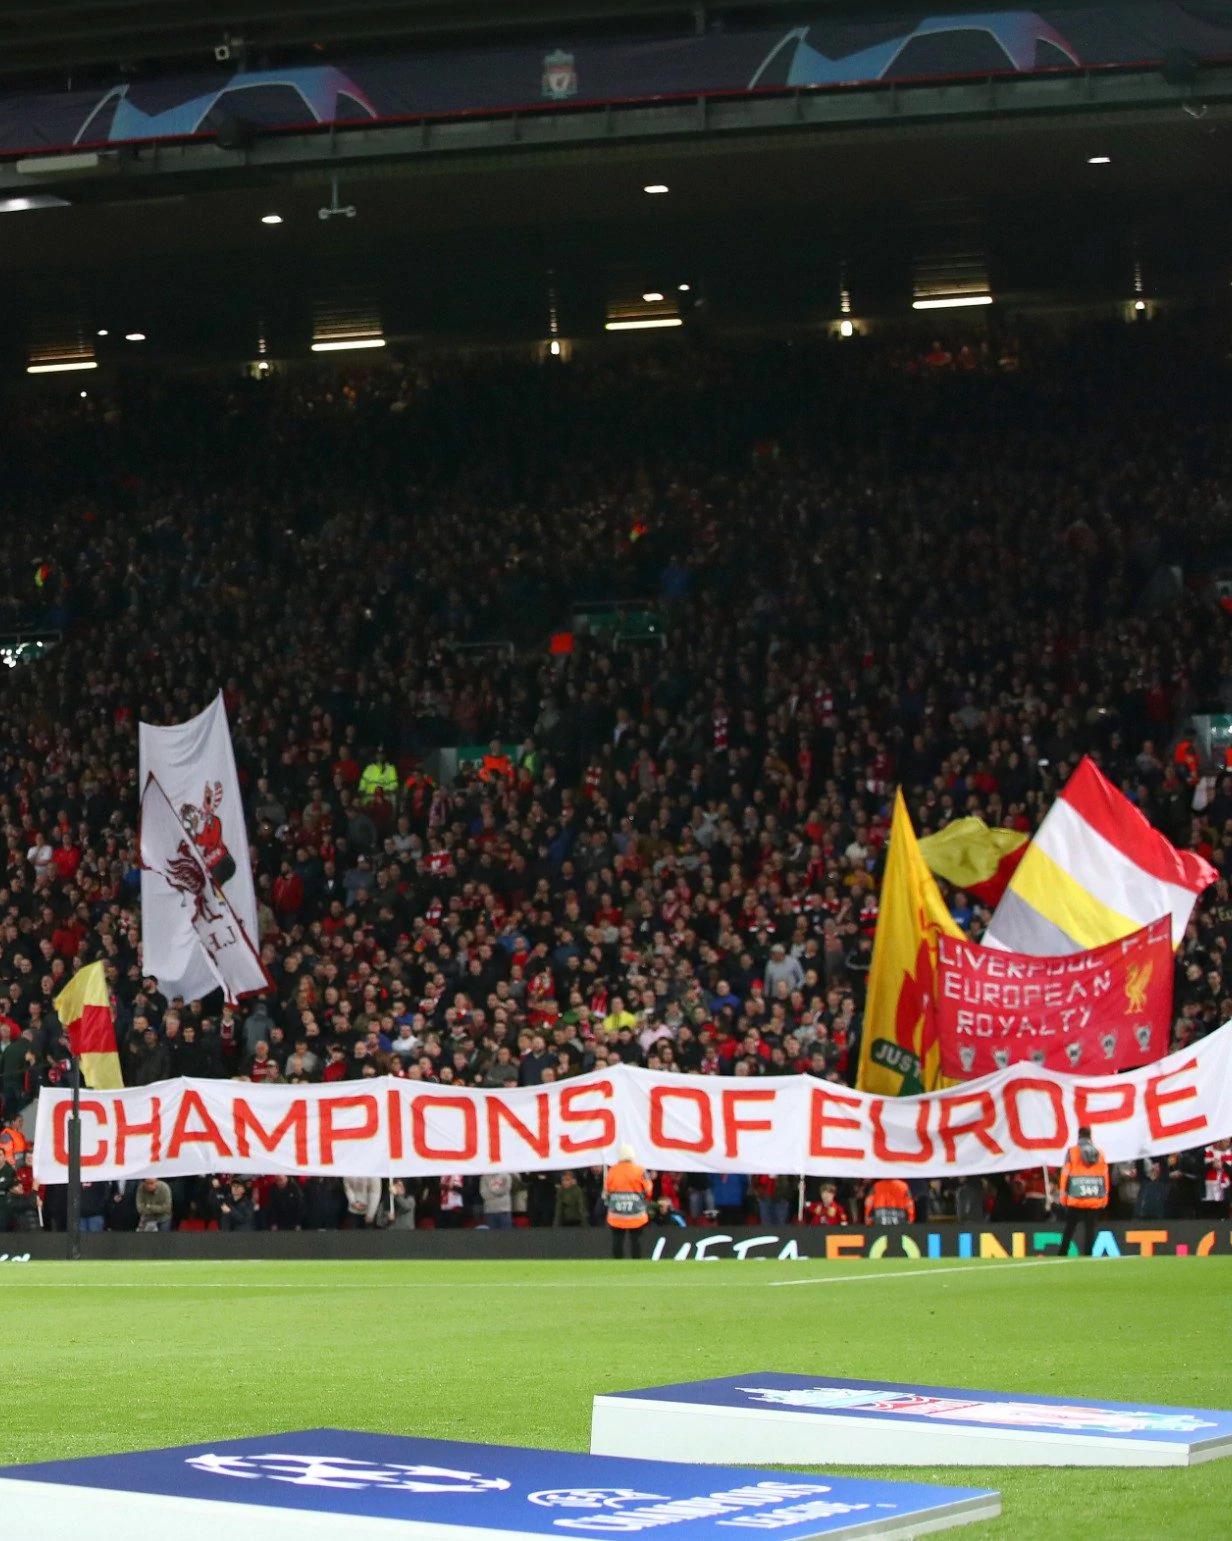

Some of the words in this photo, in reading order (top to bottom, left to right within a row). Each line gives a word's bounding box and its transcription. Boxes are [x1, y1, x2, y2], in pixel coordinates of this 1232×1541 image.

[943, 969, 1113, 1009] EUROPEAN
[956, 1005, 1093, 1038] ROYALTY
[52, 1079, 616, 1167] CHAMPIONS
[649, 1085, 776, 1158] OF
[809, 1058, 1209, 1164] EUROPE
